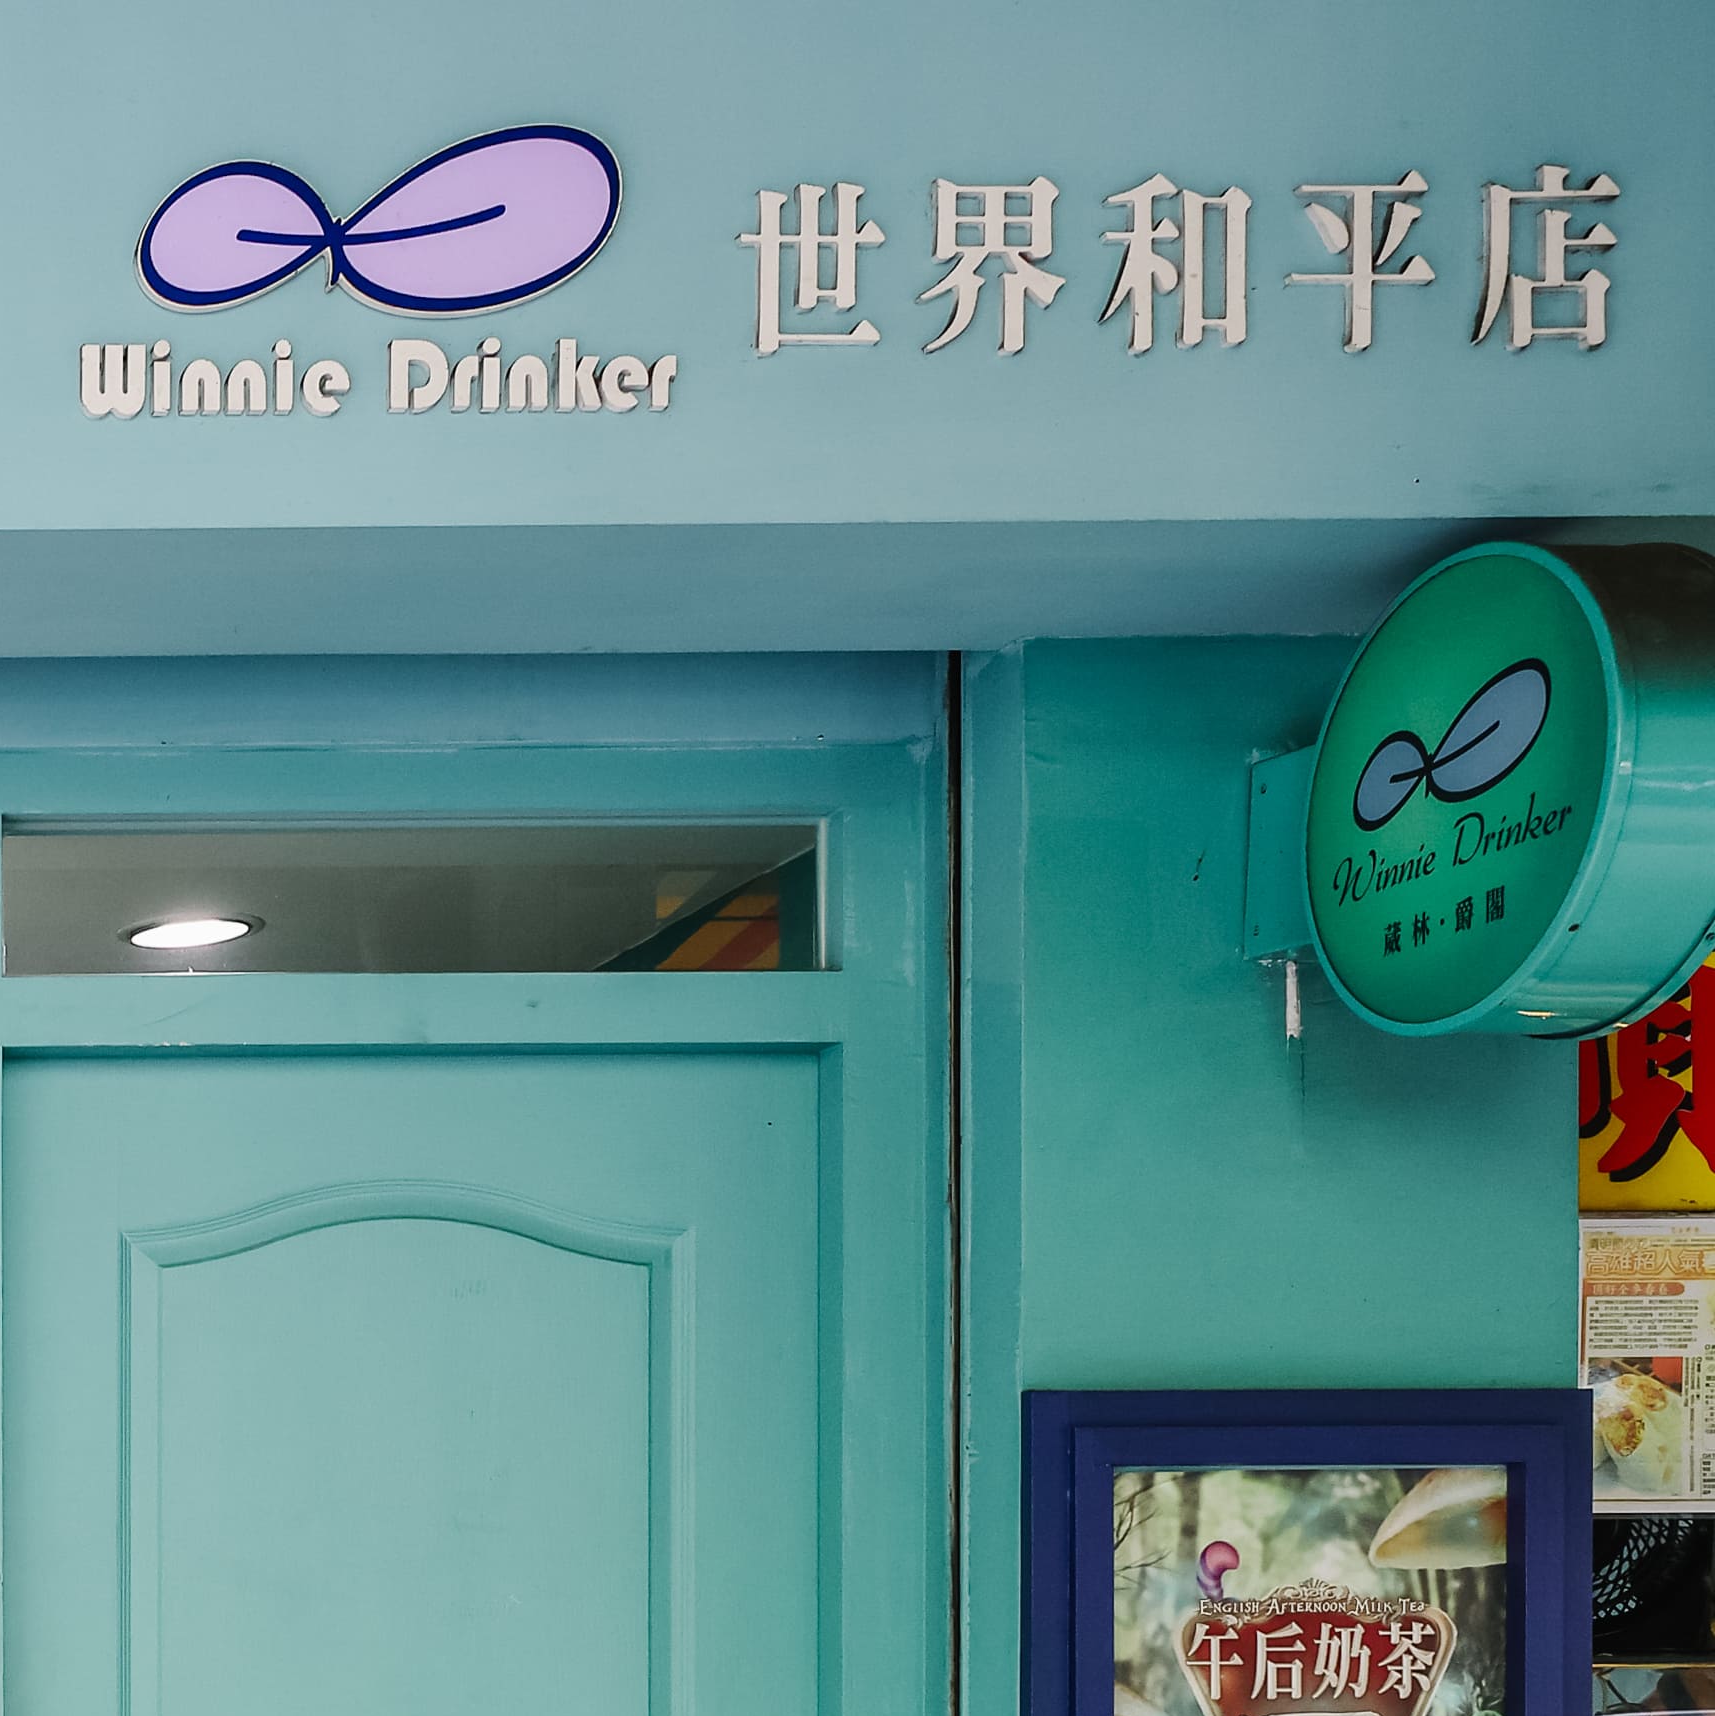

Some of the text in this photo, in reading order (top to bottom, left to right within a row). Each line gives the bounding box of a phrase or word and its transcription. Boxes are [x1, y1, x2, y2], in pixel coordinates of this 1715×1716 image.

[736, 165, 1624, 358] 世界和平店
[80, 337, 678, 418] Winnie Drinker
[1332, 791, 1573, 908] Winnie Drinker
[1198, 1598, 1393, 1616] ENGLISH AFTERNOON MILK
[1186, 1620, 1438, 1701] 午后奶茶
